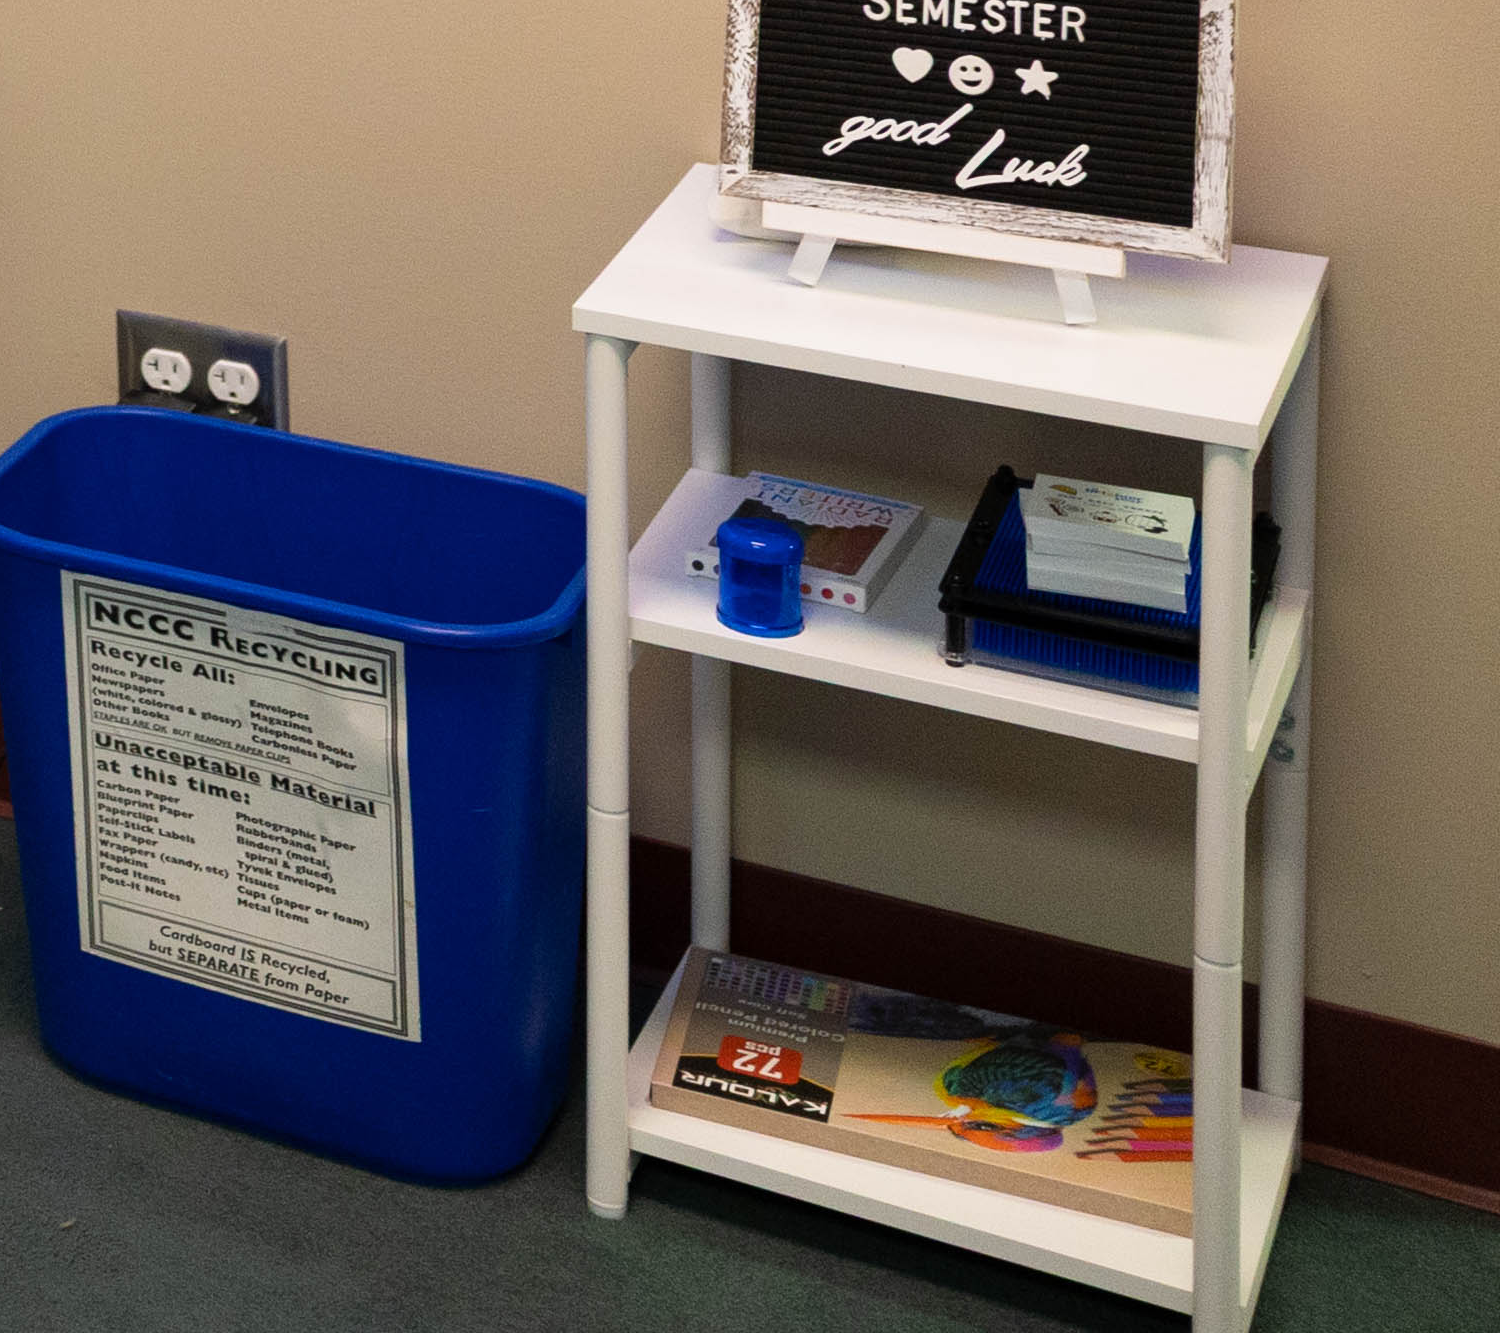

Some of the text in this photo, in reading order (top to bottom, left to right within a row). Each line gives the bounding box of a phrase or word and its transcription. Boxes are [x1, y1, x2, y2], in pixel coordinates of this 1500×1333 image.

[823, 103, 1090, 189] good Luck
[757, 491, 893, 525] RADIANT
[95, 601, 378, 684] NCCC RECYCLING
[91, 640, 235, 684] Recycle All:
[92, 663, 165, 685] Office Paper
[92, 675, 165, 697] Newspapers
[92, 687, 242, 729] (white, colored & glossy)
[93, 699, 170, 722] Other Books
[250, 700, 310, 721] Envelopes
[250, 711, 313, 734] Magazines
[251, 723, 354, 759] Telephone Books
[251, 736, 357, 771] Carbonless Paper
[95, 732, 375, 815] Unacceptable Material
[97, 759, 251, 805] at this time:
[97, 780, 180, 804] Carbon Paper
[98, 792, 194, 819] Blueprint Paper
[98, 803, 159, 824] Paperclips
[99, 827, 158, 847] Fax Paper
[159, 828, 195, 844] Labels
[236, 811, 356, 853] Photographic Paper
[236, 824, 316, 853] Rubberbands
[99, 839, 228, 879] Wrappers (candy, etc)
[237, 836, 331, 871] Binders (metal,
[245, 851, 334, 883] spiral & glued)
[100, 862, 166, 885] Food Items
[237, 860, 336, 895] Tyvek Envelopes
[237, 872, 280, 891] Tissues
[237, 885, 369, 930] Cups (paper or foam)
[237, 898, 309, 924] Metal Items
[160, 926, 331, 984] Cardboard IS Recycled,
[149, 941, 349, 1005] but SEPARATE from Paper
[696, 1002, 845, 1042] Colored Pencil
[728, 1018, 808, 1043] Premium
[732, 1049, 783, 1080] 72
[745, 1041, 781, 1056] pcs
[679, 1069, 828, 1115] KALOUR
